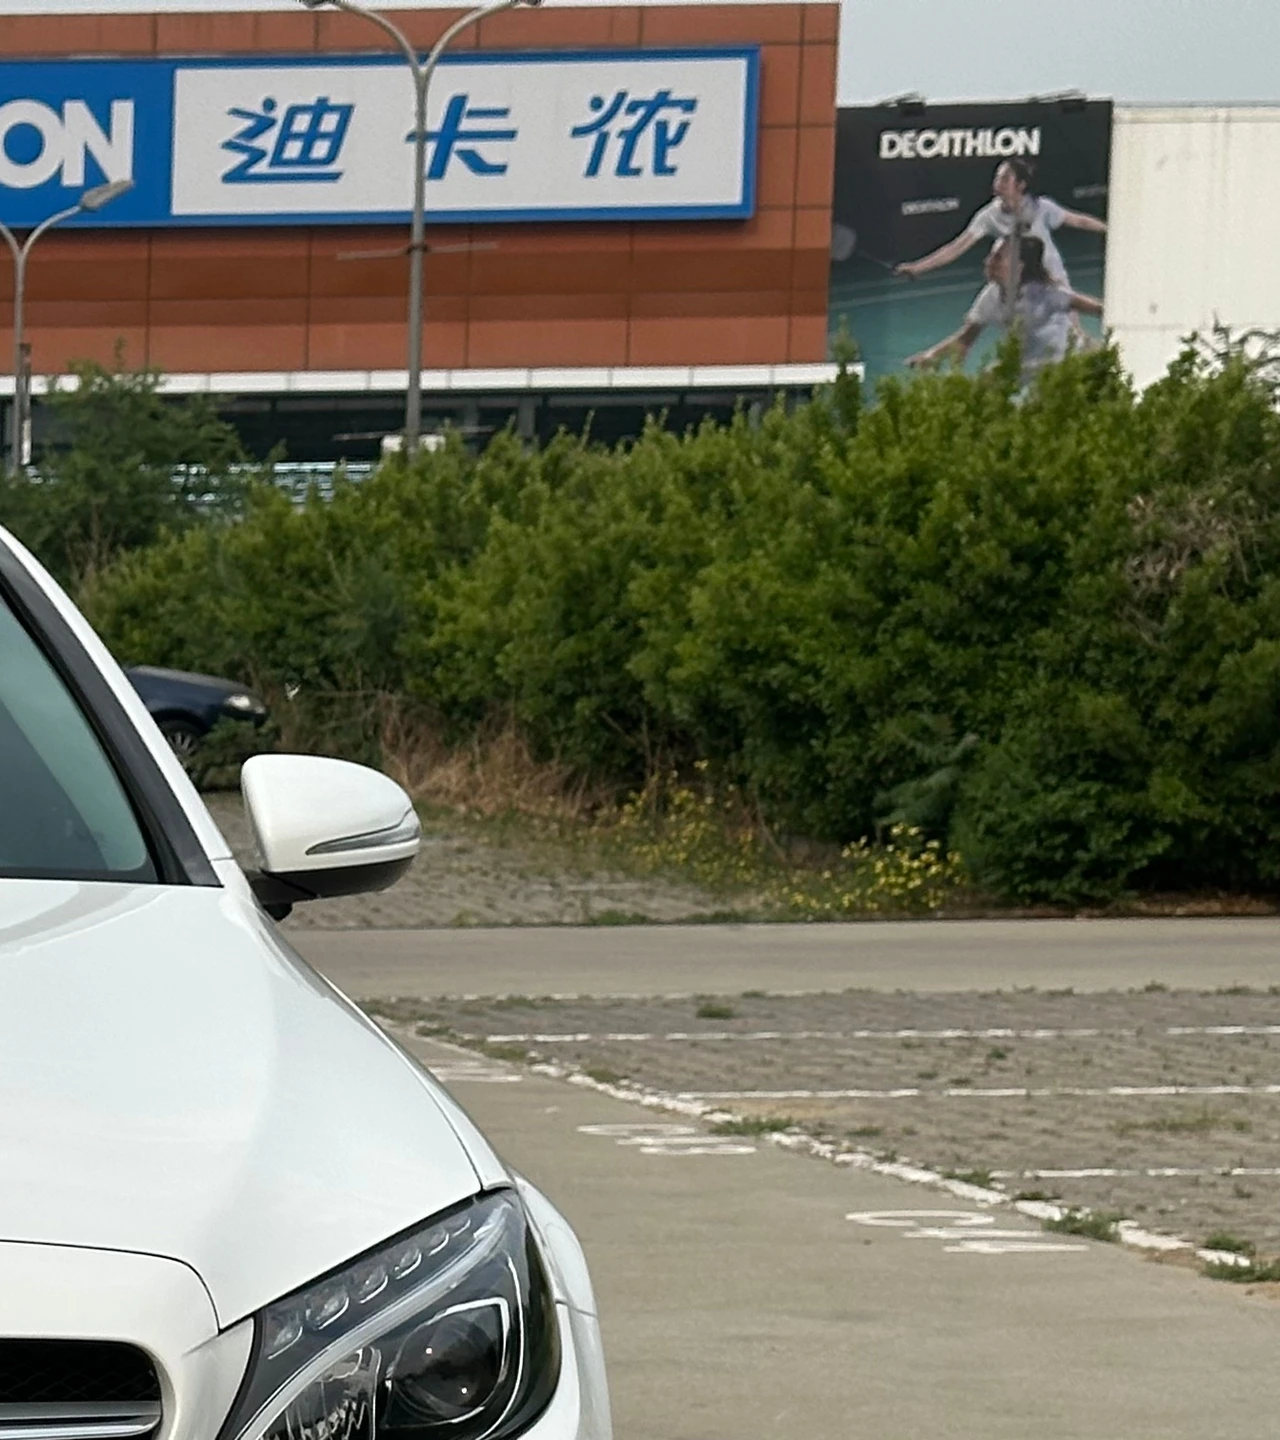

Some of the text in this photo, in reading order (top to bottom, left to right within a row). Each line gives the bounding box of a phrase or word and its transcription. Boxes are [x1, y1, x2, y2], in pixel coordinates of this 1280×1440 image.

[221, 88, 699, 184] 迪卡侬
[879, 126, 1041, 160] DECATHLON
